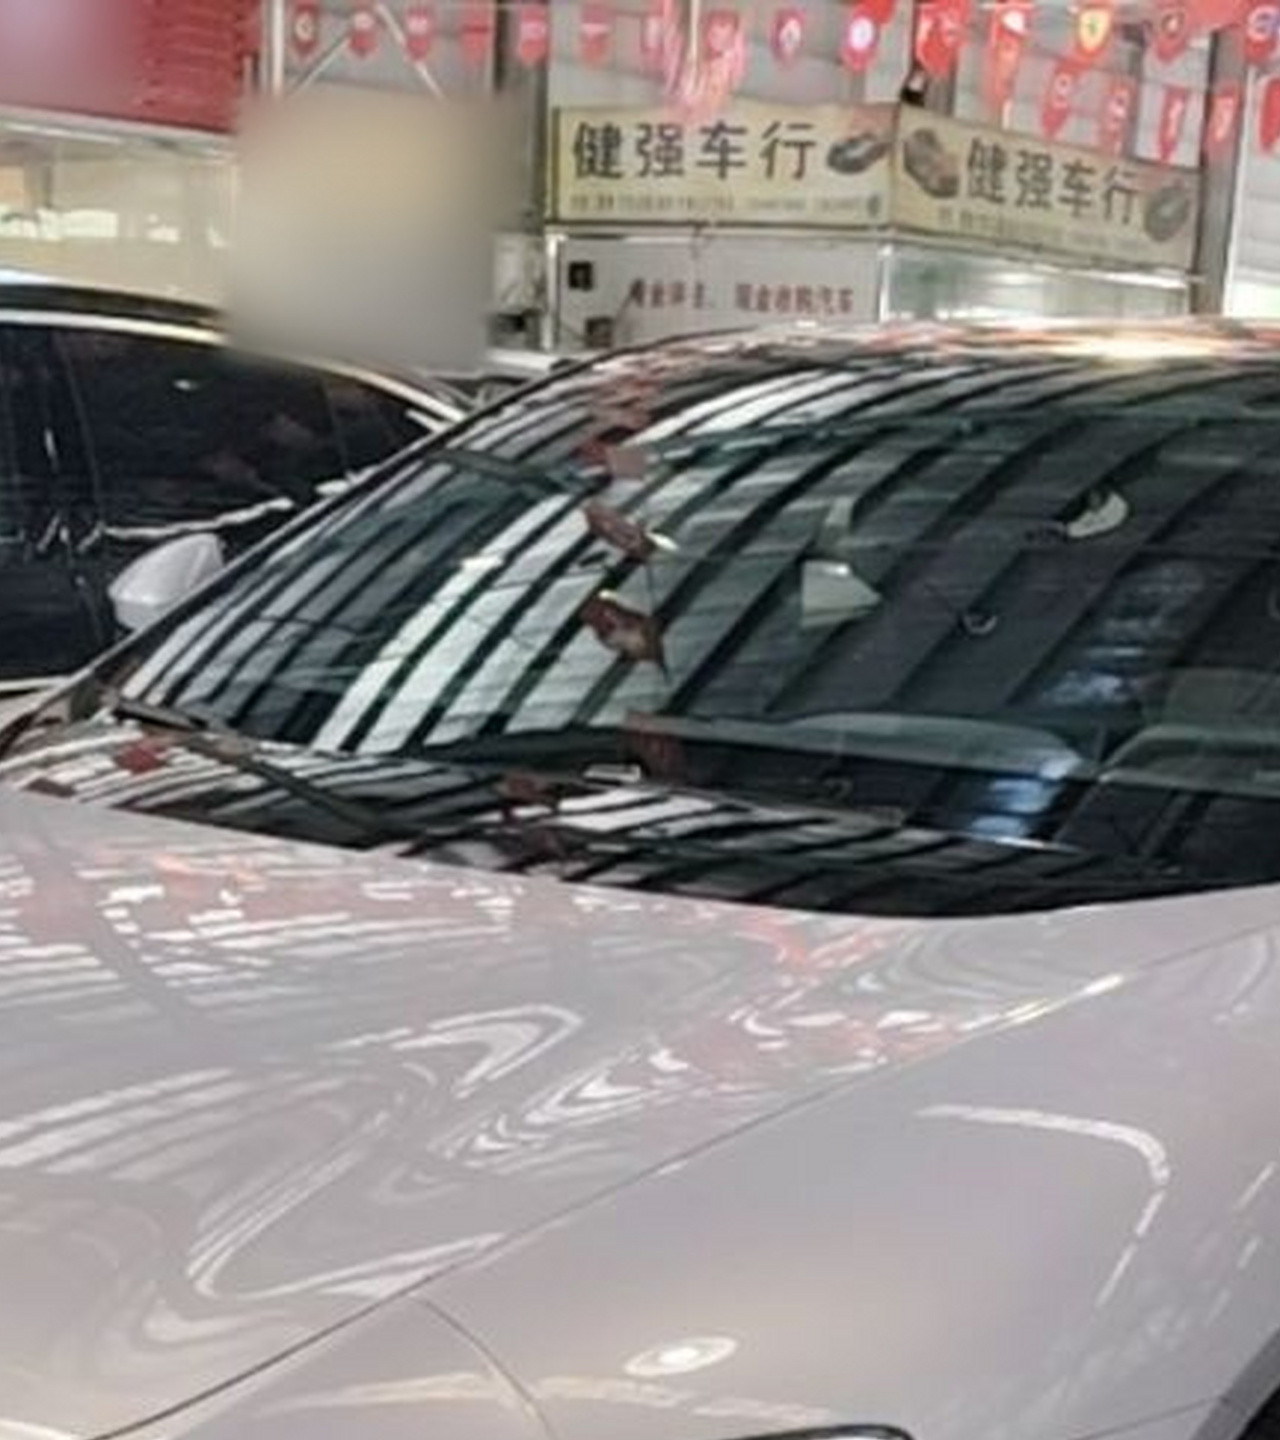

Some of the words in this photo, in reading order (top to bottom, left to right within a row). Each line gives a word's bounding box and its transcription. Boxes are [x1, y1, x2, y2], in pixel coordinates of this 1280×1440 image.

[573, 120, 817, 180] 健强车行
[968, 137, 1138, 225] 健强车行
